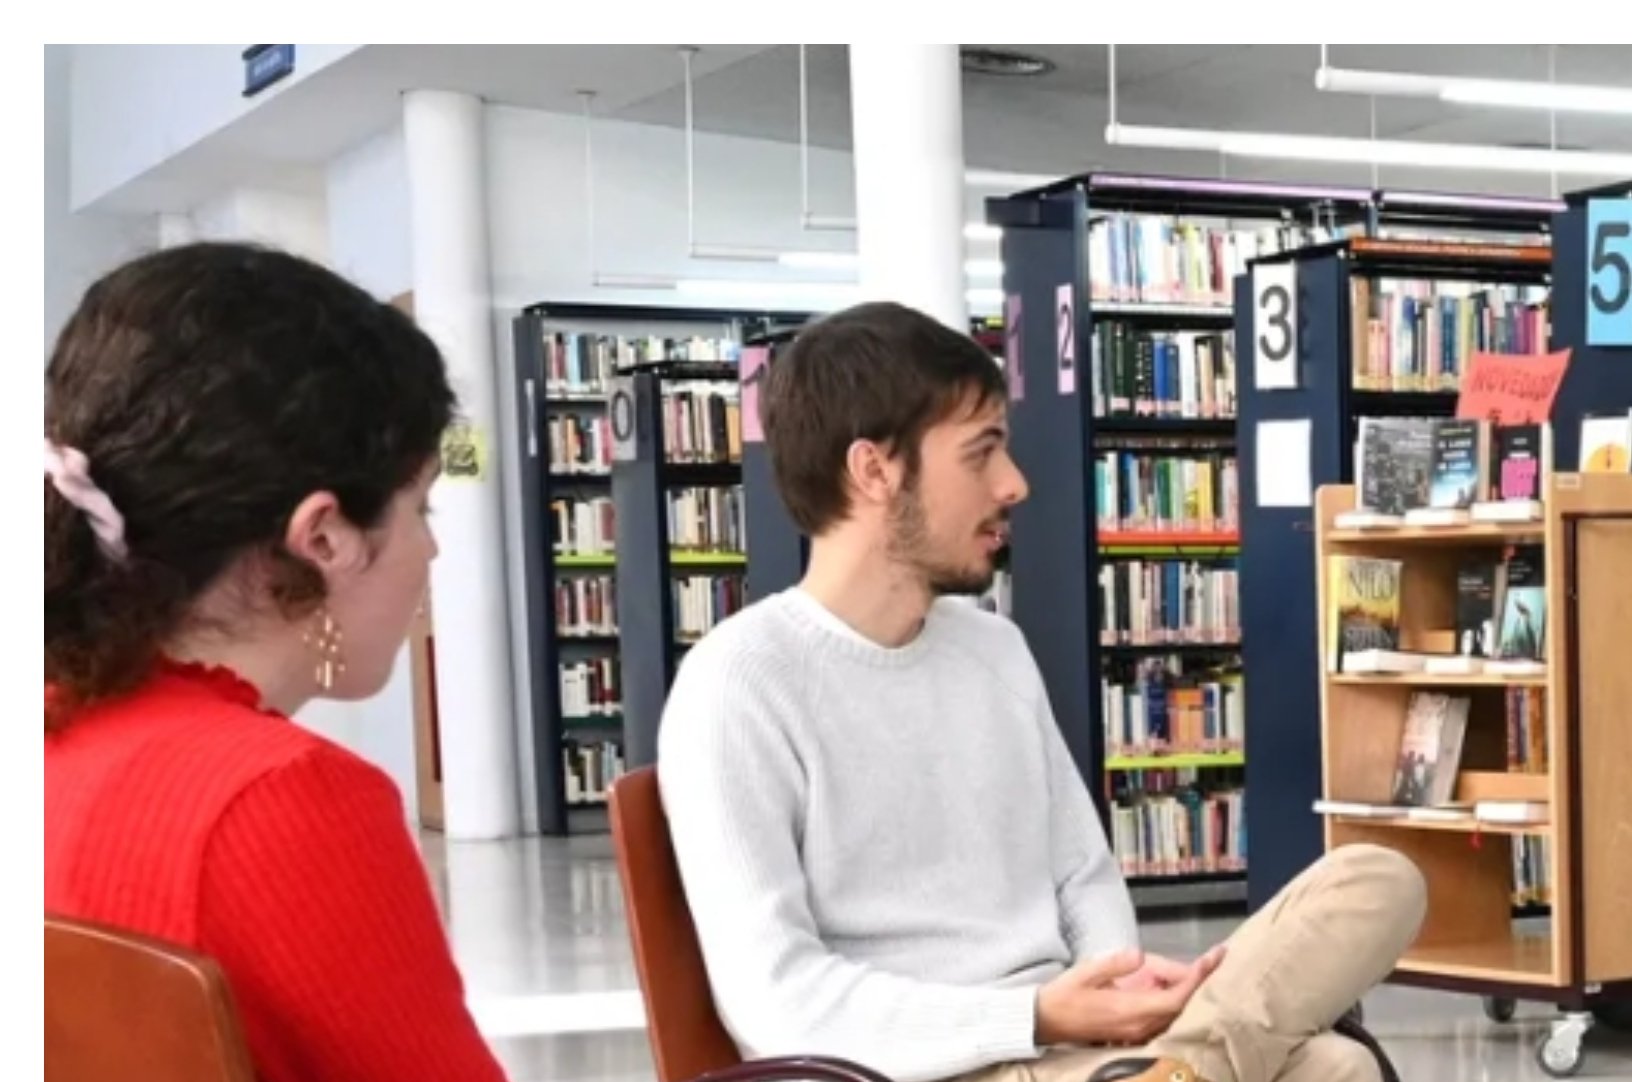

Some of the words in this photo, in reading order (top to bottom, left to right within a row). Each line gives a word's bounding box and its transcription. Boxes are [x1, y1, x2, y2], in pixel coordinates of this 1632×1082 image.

[1591, 222, 1632, 315] 5
[1059, 302, 1072, 370] 2
[1259, 285, 1293, 361] 3
[611, 390, 633, 442] 0
